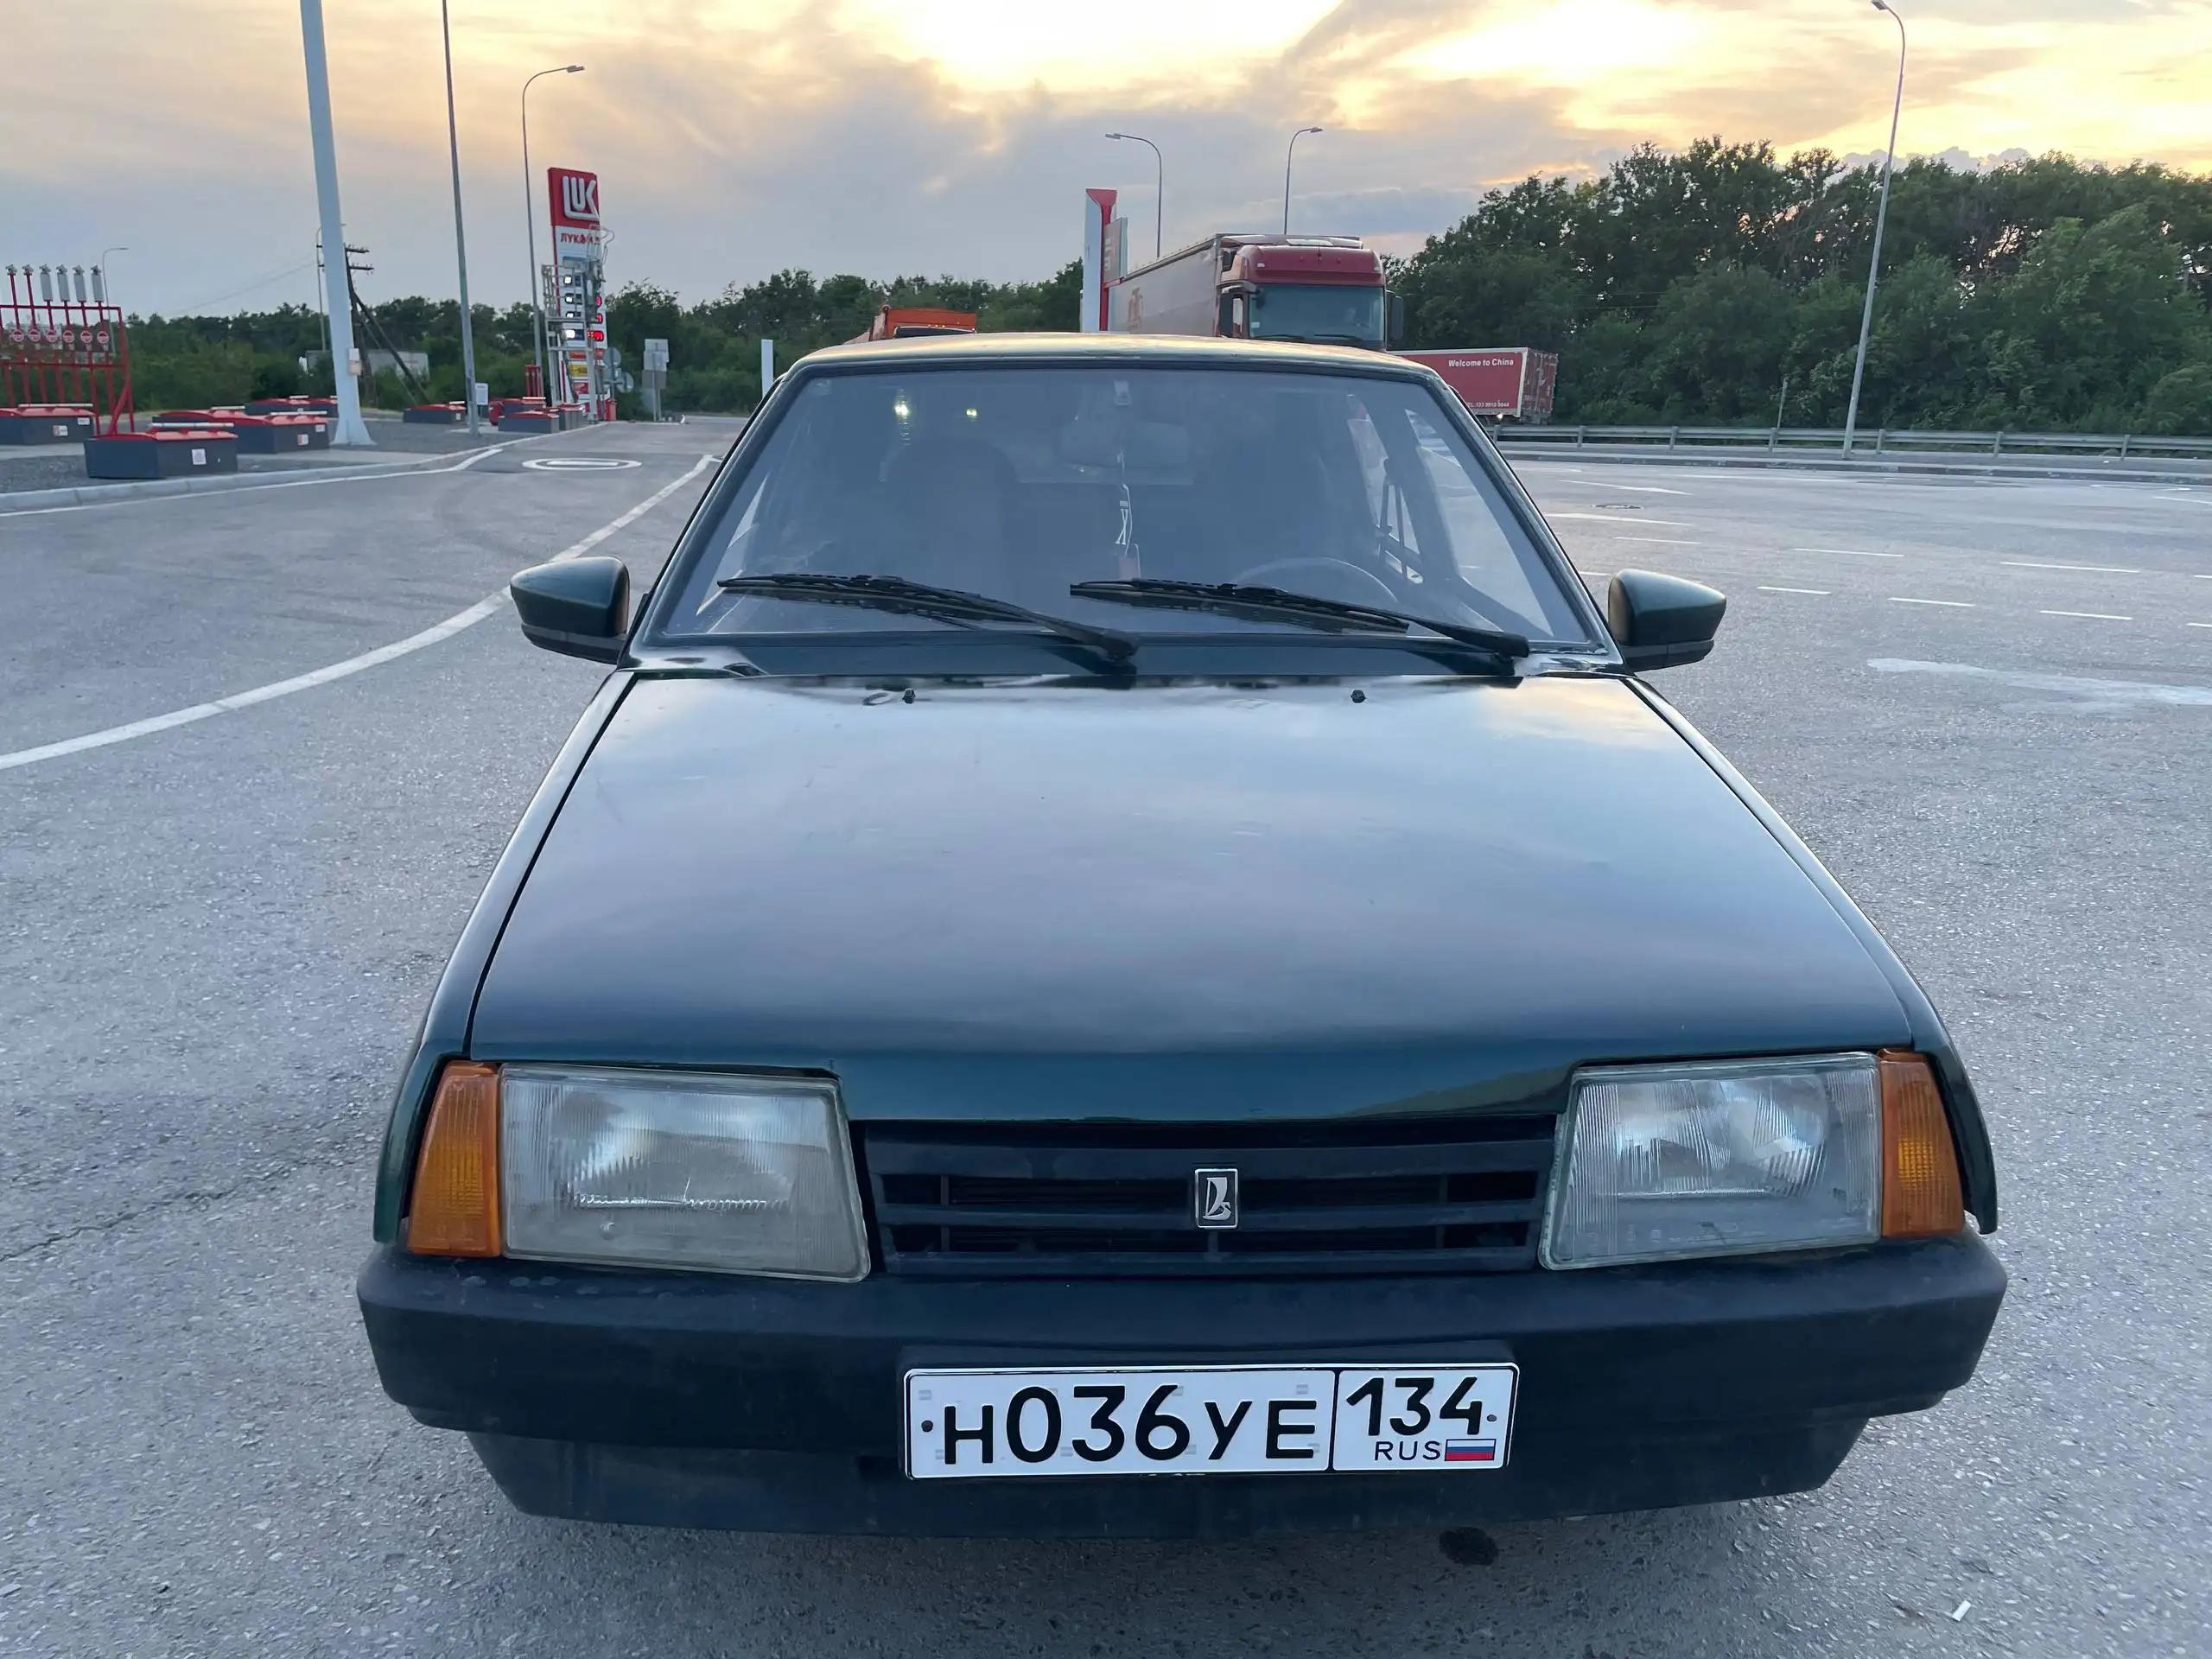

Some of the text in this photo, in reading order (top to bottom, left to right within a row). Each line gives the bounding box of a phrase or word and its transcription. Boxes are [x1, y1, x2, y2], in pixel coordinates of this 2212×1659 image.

[1448, 359, 1482, 367] Welcome
[1491, 358, 1514, 366] China
[1345, 1376, 1482, 1436] 134
[1374, 1440, 1441, 1461] RUS
